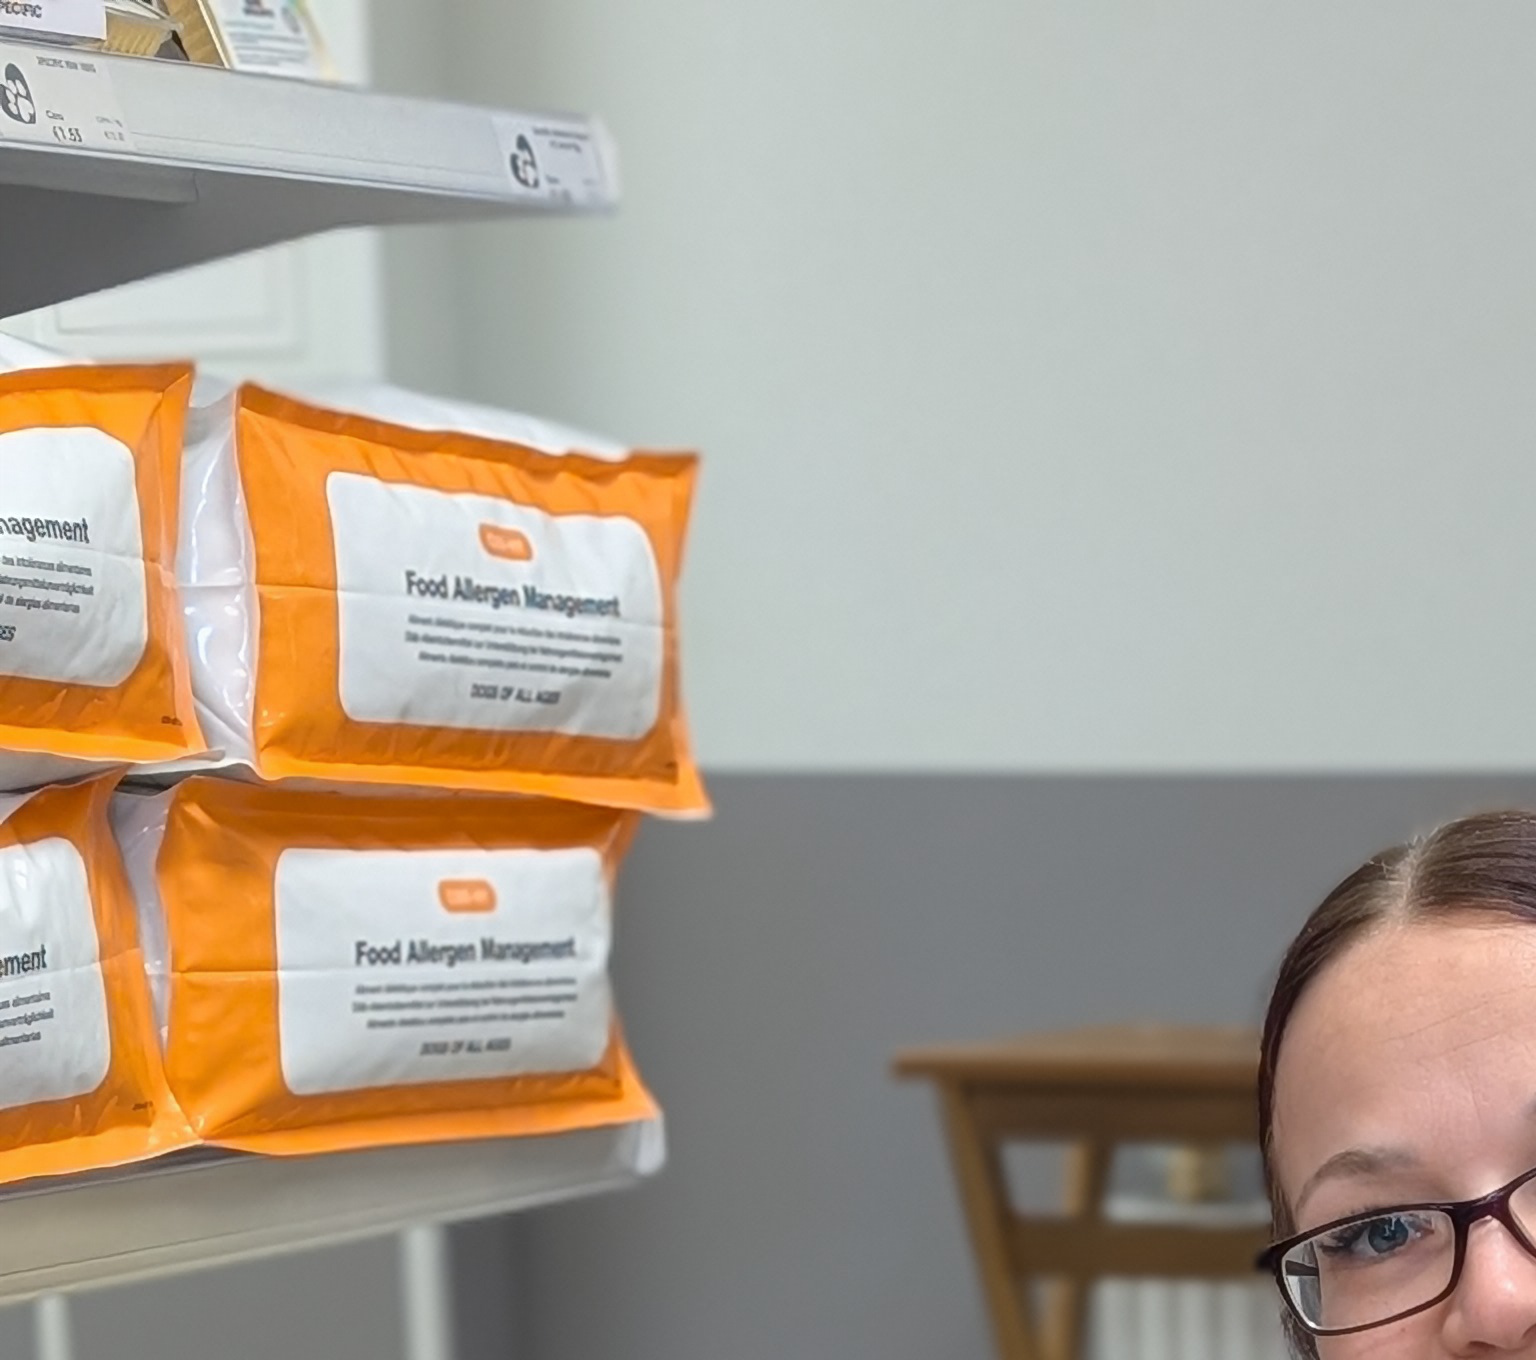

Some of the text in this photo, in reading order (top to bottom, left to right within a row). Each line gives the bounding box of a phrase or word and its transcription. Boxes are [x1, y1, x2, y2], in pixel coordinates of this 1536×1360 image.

[404, 569, 622, 619] Food Allergen Management
[355, 935, 578, 968] Food Allergen Management
